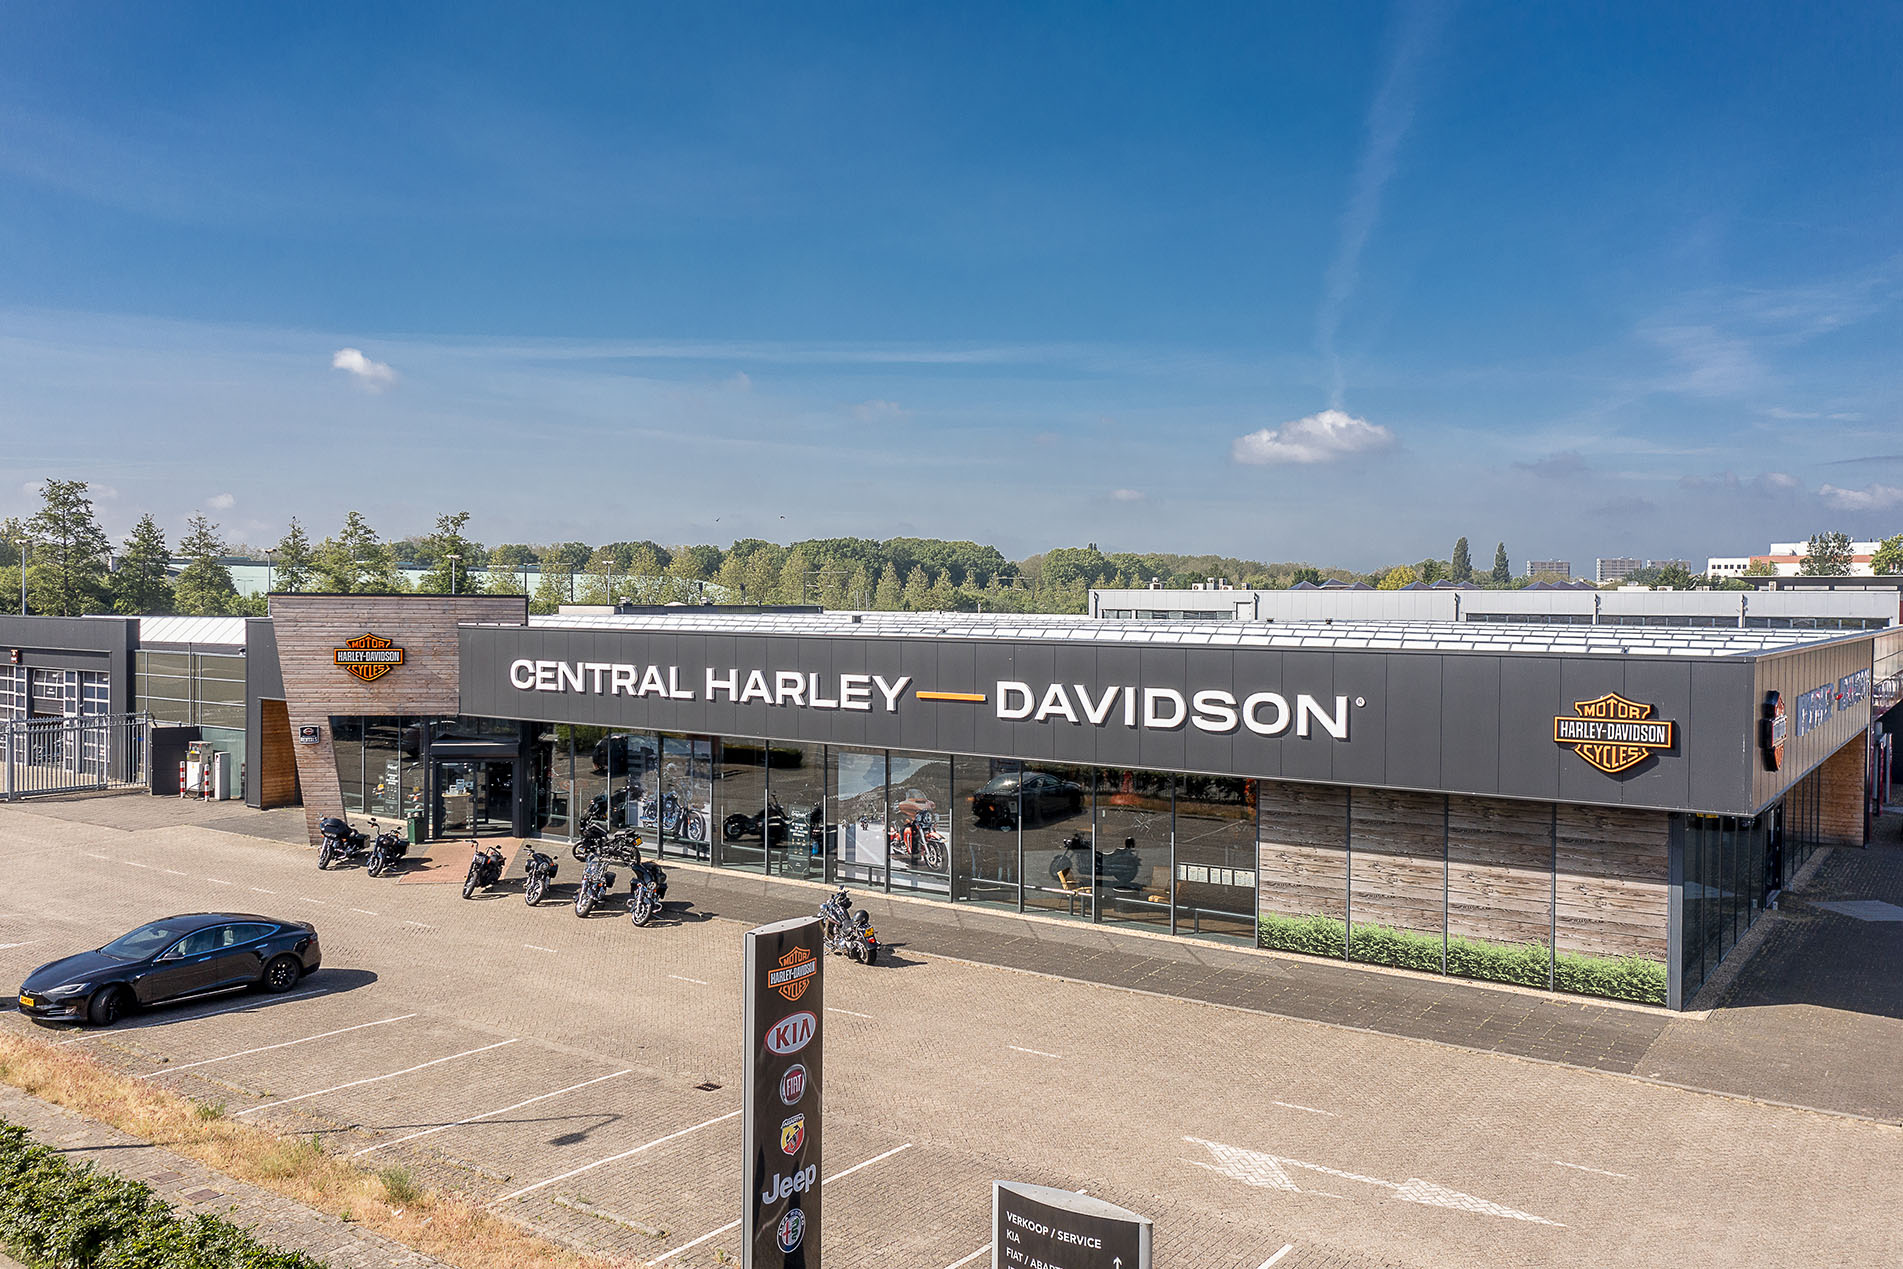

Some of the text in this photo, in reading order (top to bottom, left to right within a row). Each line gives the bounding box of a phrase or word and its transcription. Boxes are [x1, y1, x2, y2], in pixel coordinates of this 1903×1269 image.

[351, 636, 385, 648] MOTOR
[337, 651, 400, 662] HARLEY-DAVIDSON
[351, 664, 385, 678] CYCLES
[510, 658, 695, 699] CENTRAL
[705, 667, 912, 711] HARLEY
[996, 680, 1349, 739] DAVIDSON
[1584, 698, 1640, 719] MOTOR
[1560, 720, 1666, 743] HARLEY-DAVIDSON
[1583, 744, 1639, 768] CYCLES
[783, 949, 807, 967] MOTOR
[770, 960, 816, 985] HARLEY-DAVIDSON
[783, 980, 807, 998] CYCLES
[775, 1018, 811, 1050] KIA
[786, 1073, 802, 1097] FIAT
[762, 1163, 817, 1205] Jeep
[1006, 1210, 1049, 1236] VERKOOP
[1057, 1230, 1102, 1249] SERVICE
[1006, 1229, 1021, 1244] KIA
[1006, 1246, 1024, 1263] FIAT
